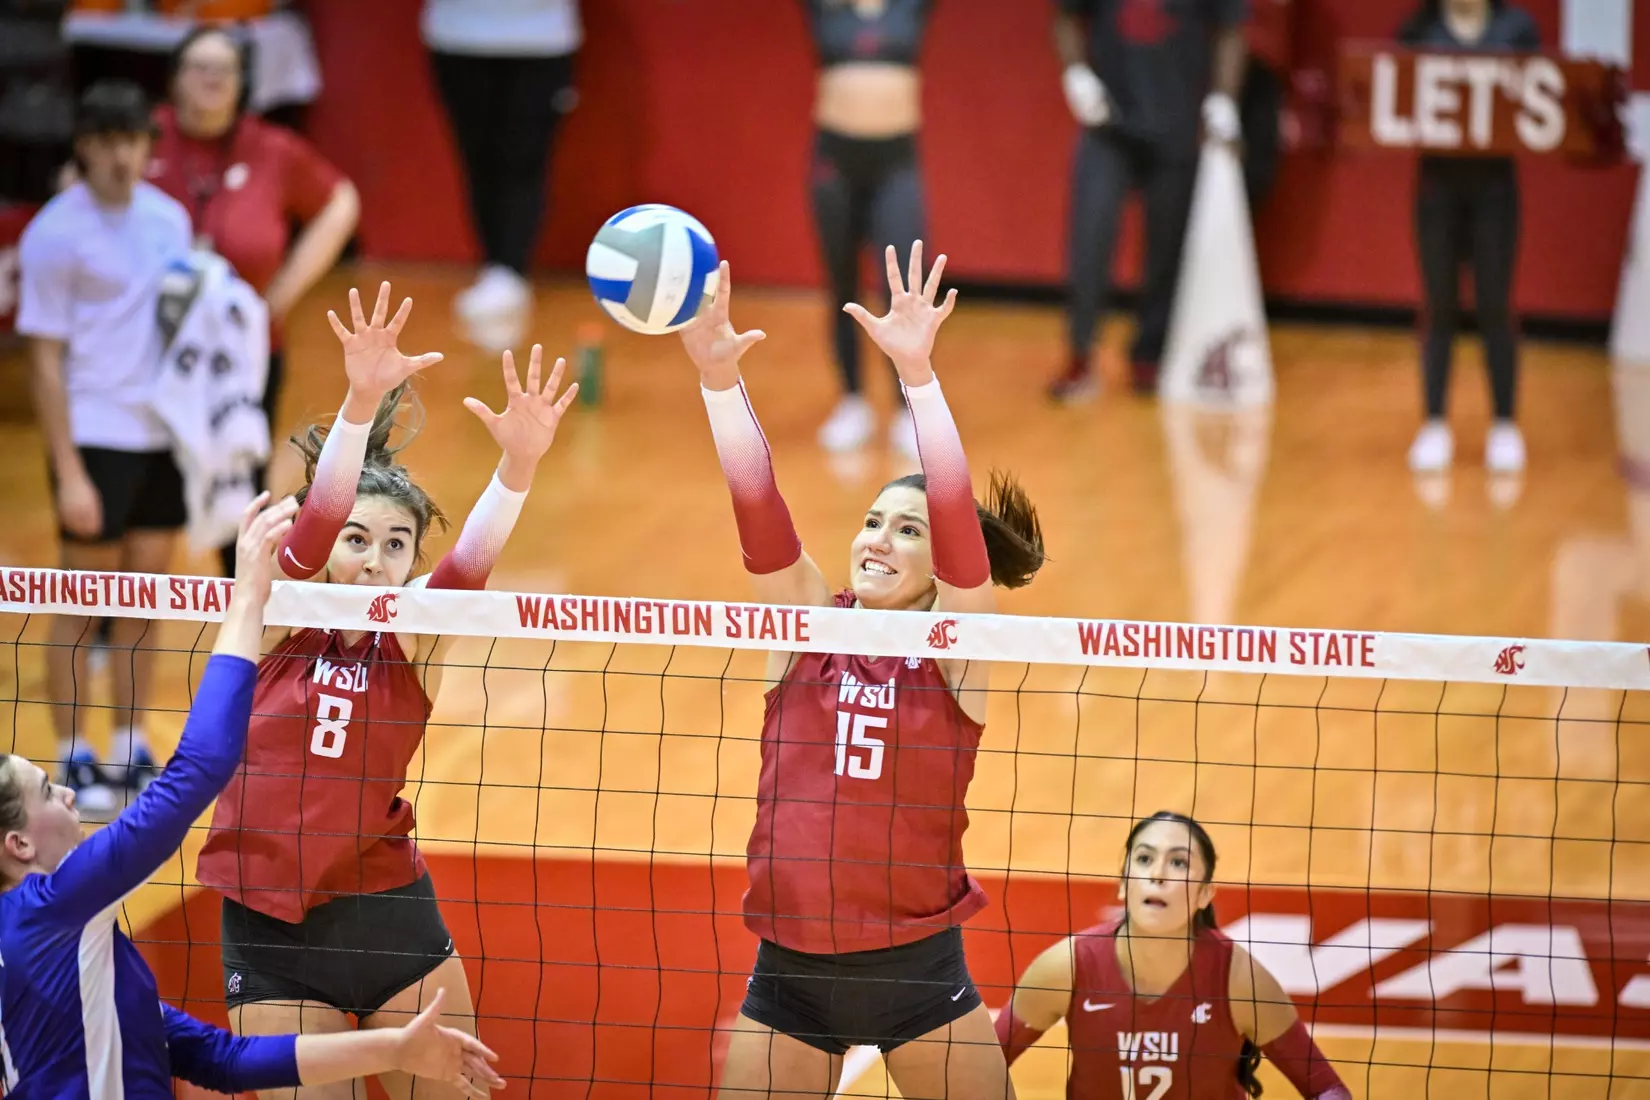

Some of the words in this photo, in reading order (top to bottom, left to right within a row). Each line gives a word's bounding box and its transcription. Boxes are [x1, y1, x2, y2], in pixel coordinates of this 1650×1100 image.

[1371, 52, 1566, 150] LET'S
[0, 570, 156, 609] ASHINGTON
[168, 577, 235, 612] STAT
[515, 595, 712, 636] WASHINGTON
[725, 604, 810, 642] STATE
[1077, 621, 1277, 663] WASHINGTON
[1289, 632, 1375, 668] STATE
[313, 656, 368, 693] WSU
[838, 671, 896, 709] WSU
[310, 693, 353, 758] 8
[834, 711, 888, 780] 15
[1117, 1031, 1179, 1062] WSU
[1119, 1066, 1173, 1100] 12
